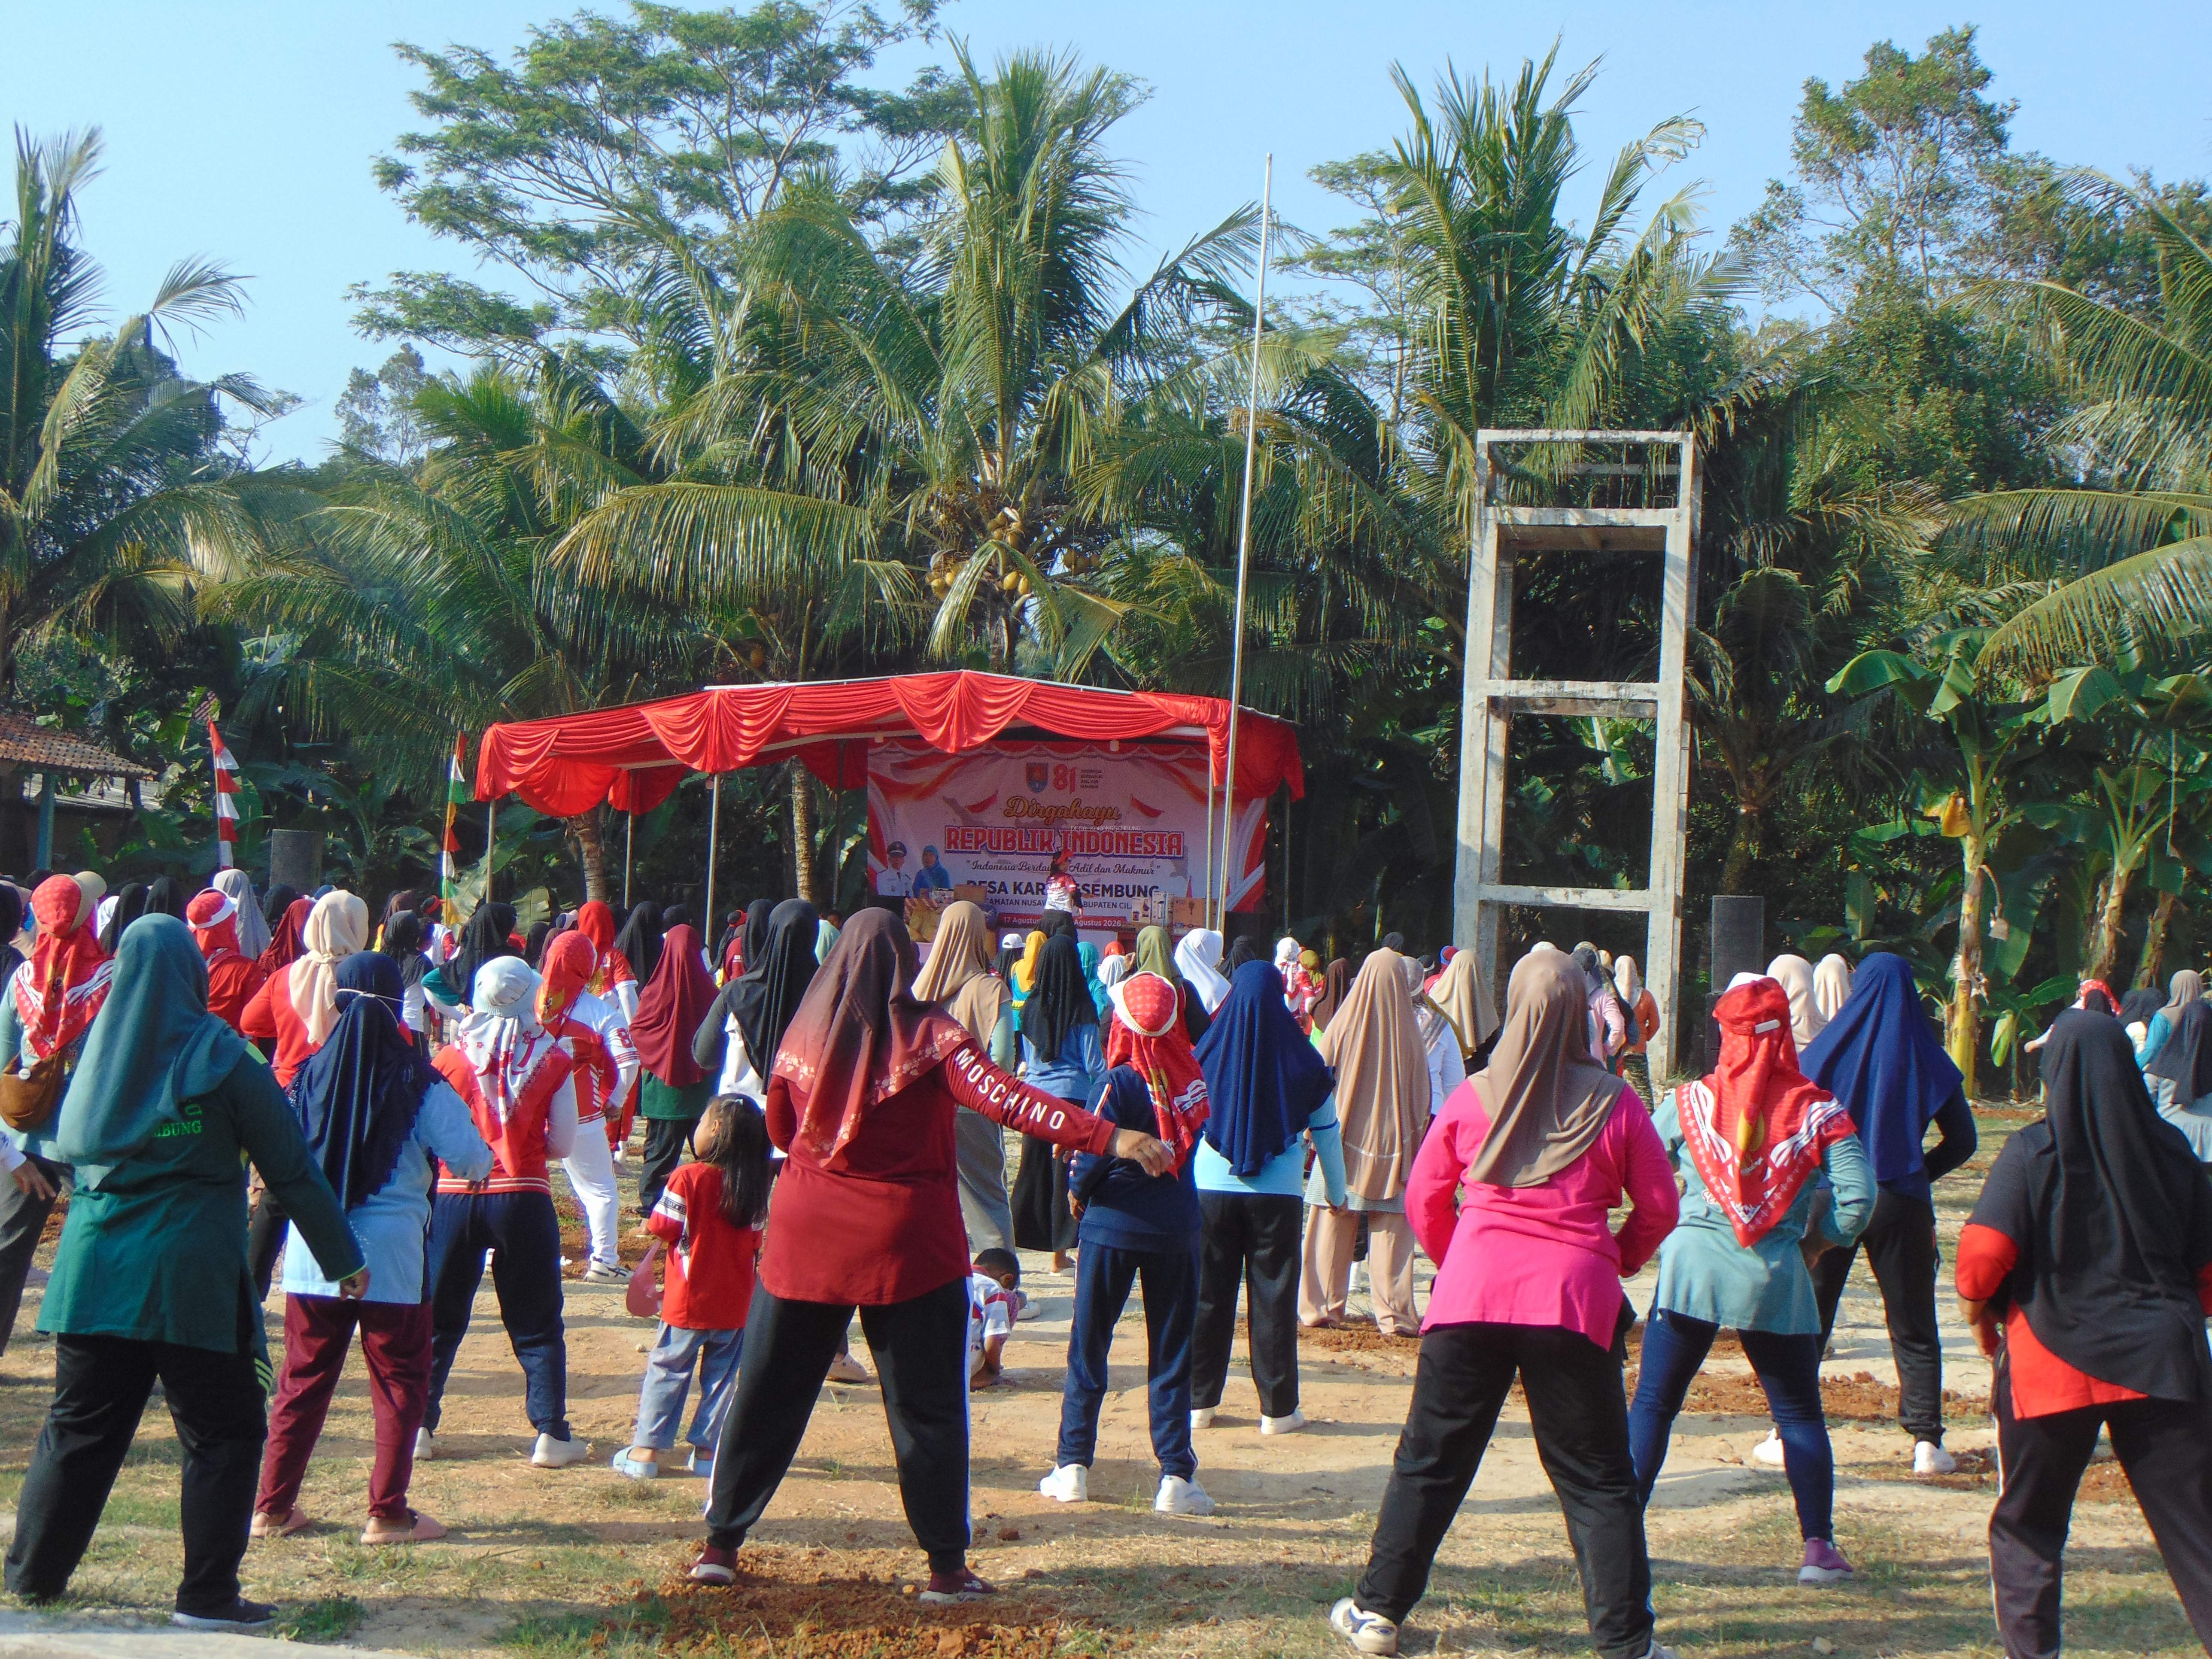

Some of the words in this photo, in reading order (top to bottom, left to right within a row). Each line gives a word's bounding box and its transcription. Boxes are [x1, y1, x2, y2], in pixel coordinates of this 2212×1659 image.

[1003, 796, 1122, 826] Dirgahayu
[945, 826, 1054, 854] REPUBLIK
[1059, 830, 1183, 858] INDONESIA
[1094, 863, 1111, 873] dan
[955, 1048, 1065, 1130] MOSCHINO
